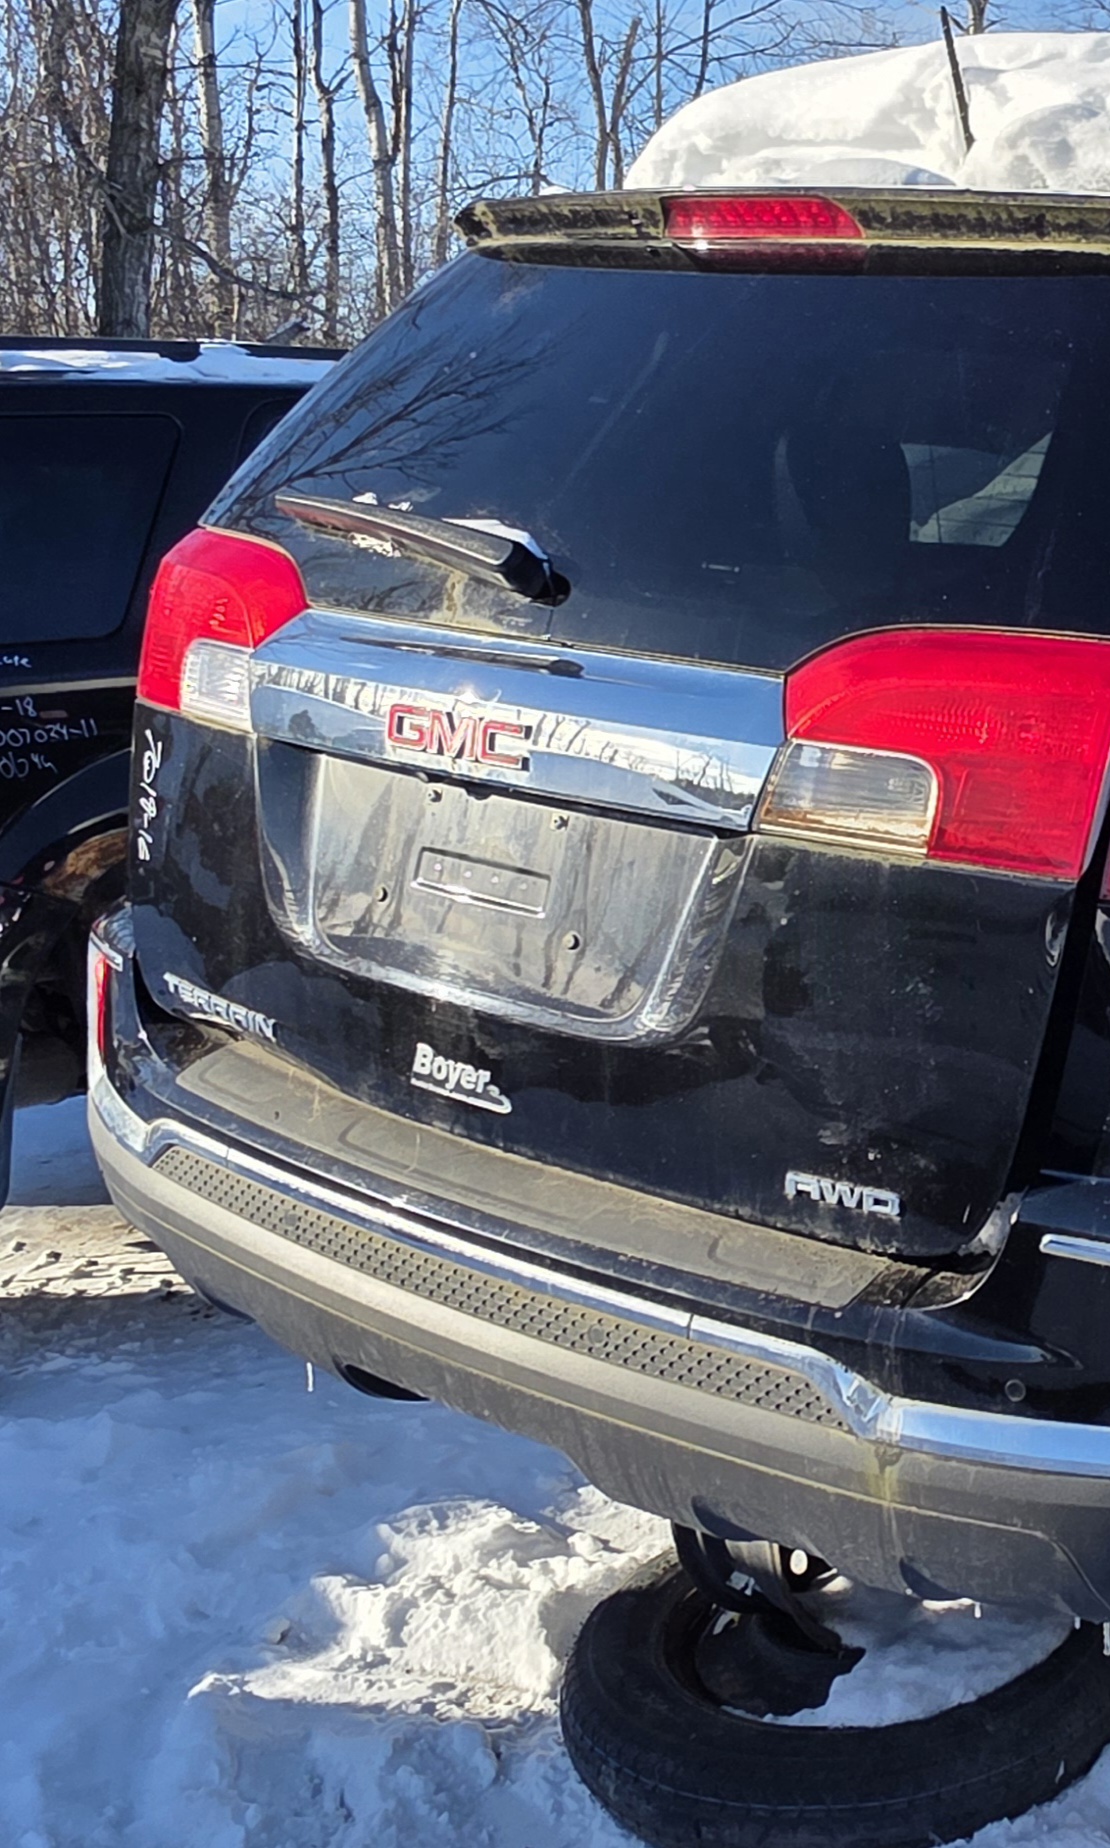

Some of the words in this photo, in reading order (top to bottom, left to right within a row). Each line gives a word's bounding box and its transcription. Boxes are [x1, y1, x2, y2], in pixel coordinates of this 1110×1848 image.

[386, 703, 528, 770] GMC
[162, 971, 278, 1043] TERRAIN
[412, 1042, 491, 1094] Boyer
[784, 1170, 901, 1217] AWD
